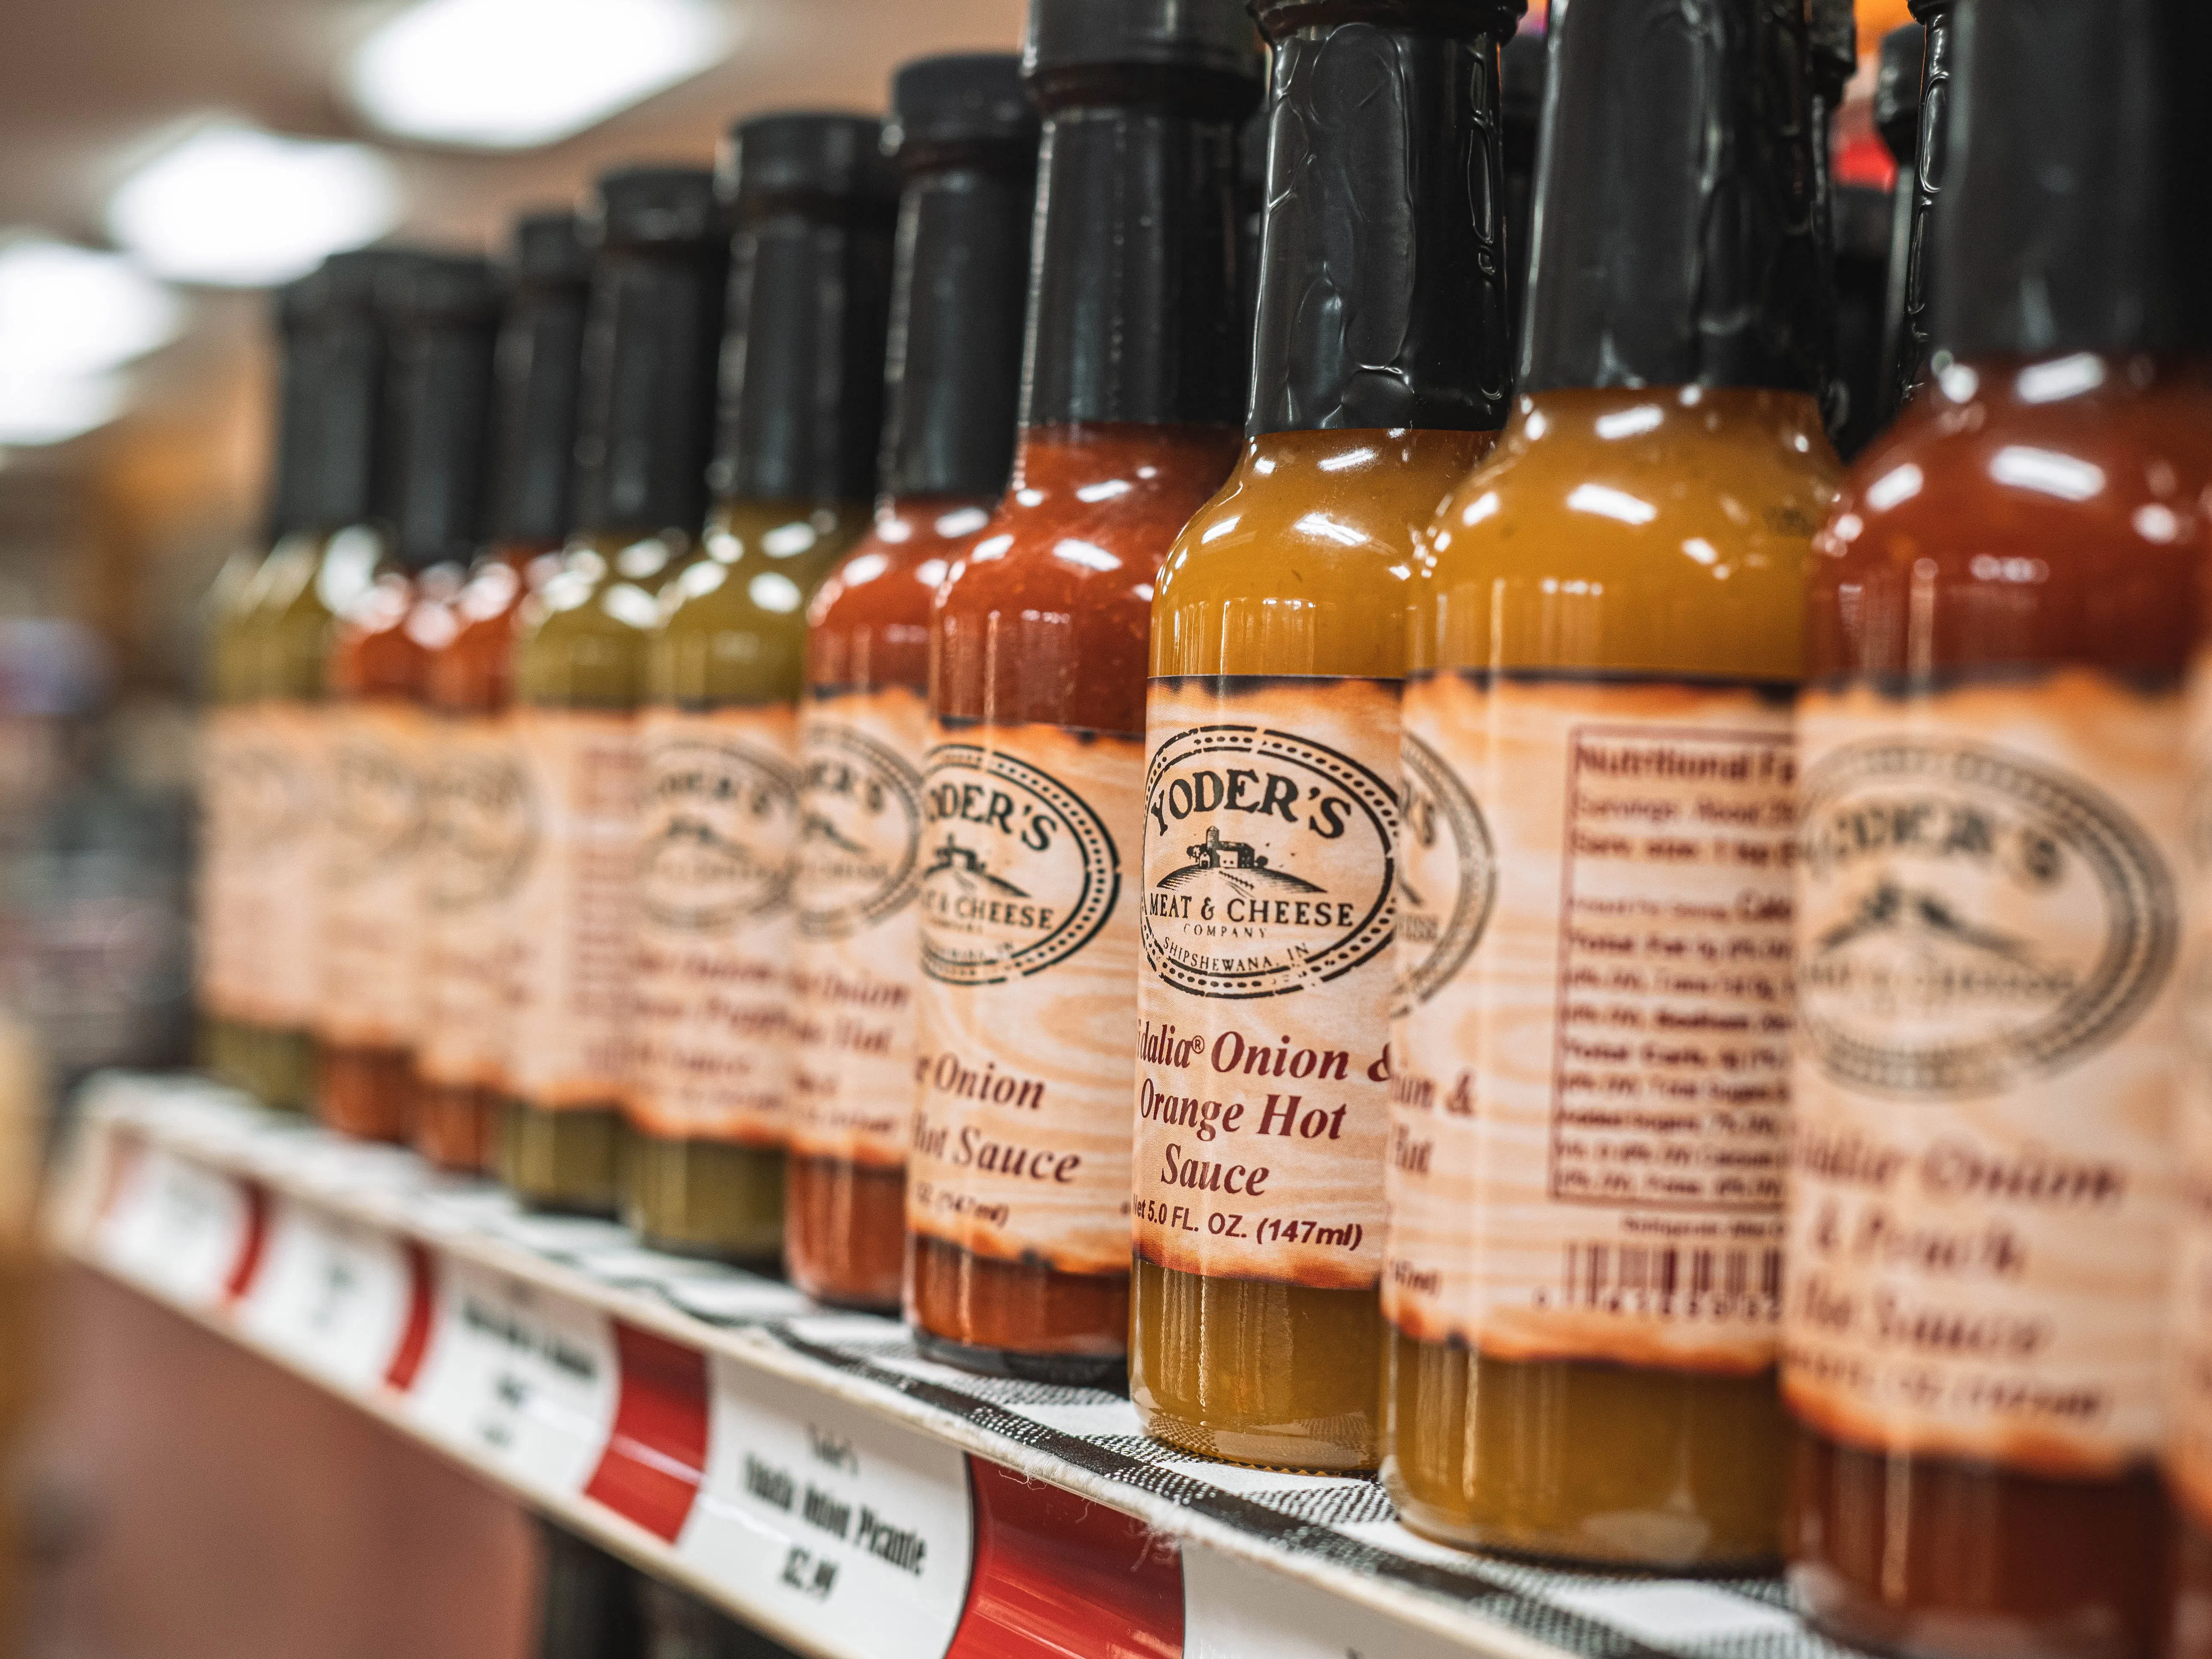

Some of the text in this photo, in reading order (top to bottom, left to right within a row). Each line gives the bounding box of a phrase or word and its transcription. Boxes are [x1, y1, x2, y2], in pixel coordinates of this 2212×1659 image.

[1151, 768, 1352, 839] YODER'S
[954, 894, 1054, 930] CHEESE
[1149, 892, 1354, 927] MEAT & CHEESE
[1184, 923, 1266, 938] COMPANY
[1287, 942, 1309, 960] IN
[1137, 1018, 1390, 1081] idalia® Onion &
[933, 1051, 1046, 1111] Onion
[1140, 1078, 1347, 1142] Orange Hot
[953, 1125, 1083, 1183] Sauce
[1161, 1143, 1270, 1196] Sauce
[1133, 1193, 1146, 1219] Net
[1148, 1200, 1168, 1225] 5.0
[1171, 1206, 1199, 1232] FL.
[1208, 1212, 1247, 1238] OZ.
[1256, 1217, 1363, 1251] (147ml)
